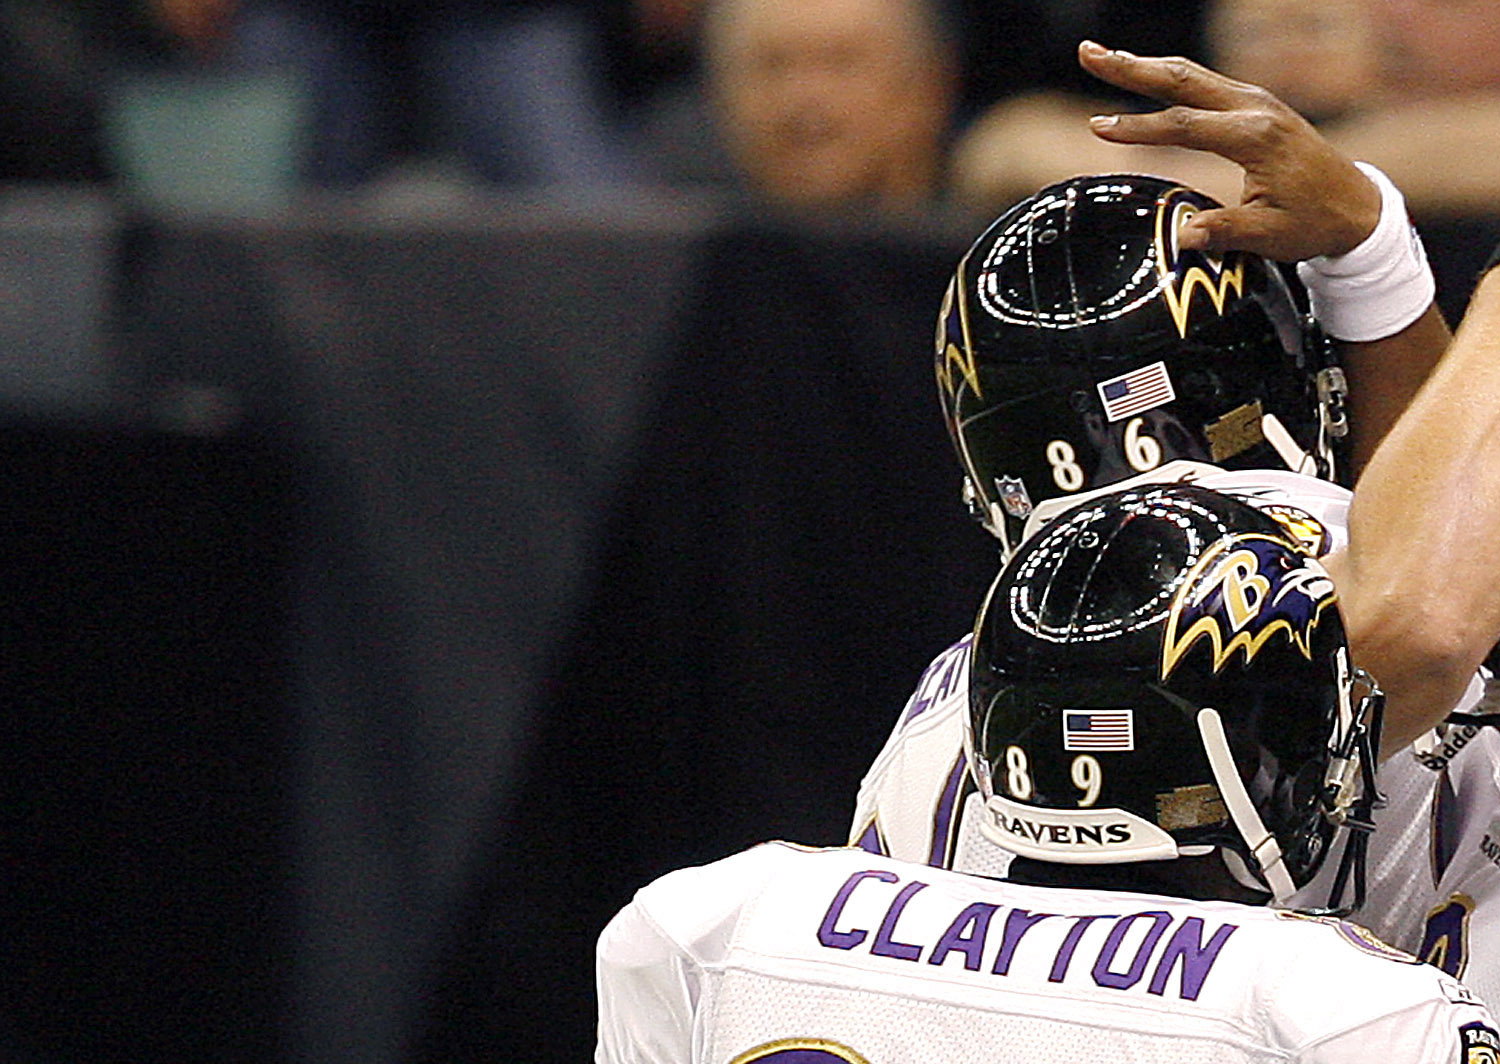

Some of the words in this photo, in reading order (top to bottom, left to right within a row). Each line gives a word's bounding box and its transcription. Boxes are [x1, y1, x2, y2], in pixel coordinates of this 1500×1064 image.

[1193, 549, 1271, 633] B
[990, 807, 1132, 846] RAVENS
[816, 869, 1240, 1002] CLAYTON
